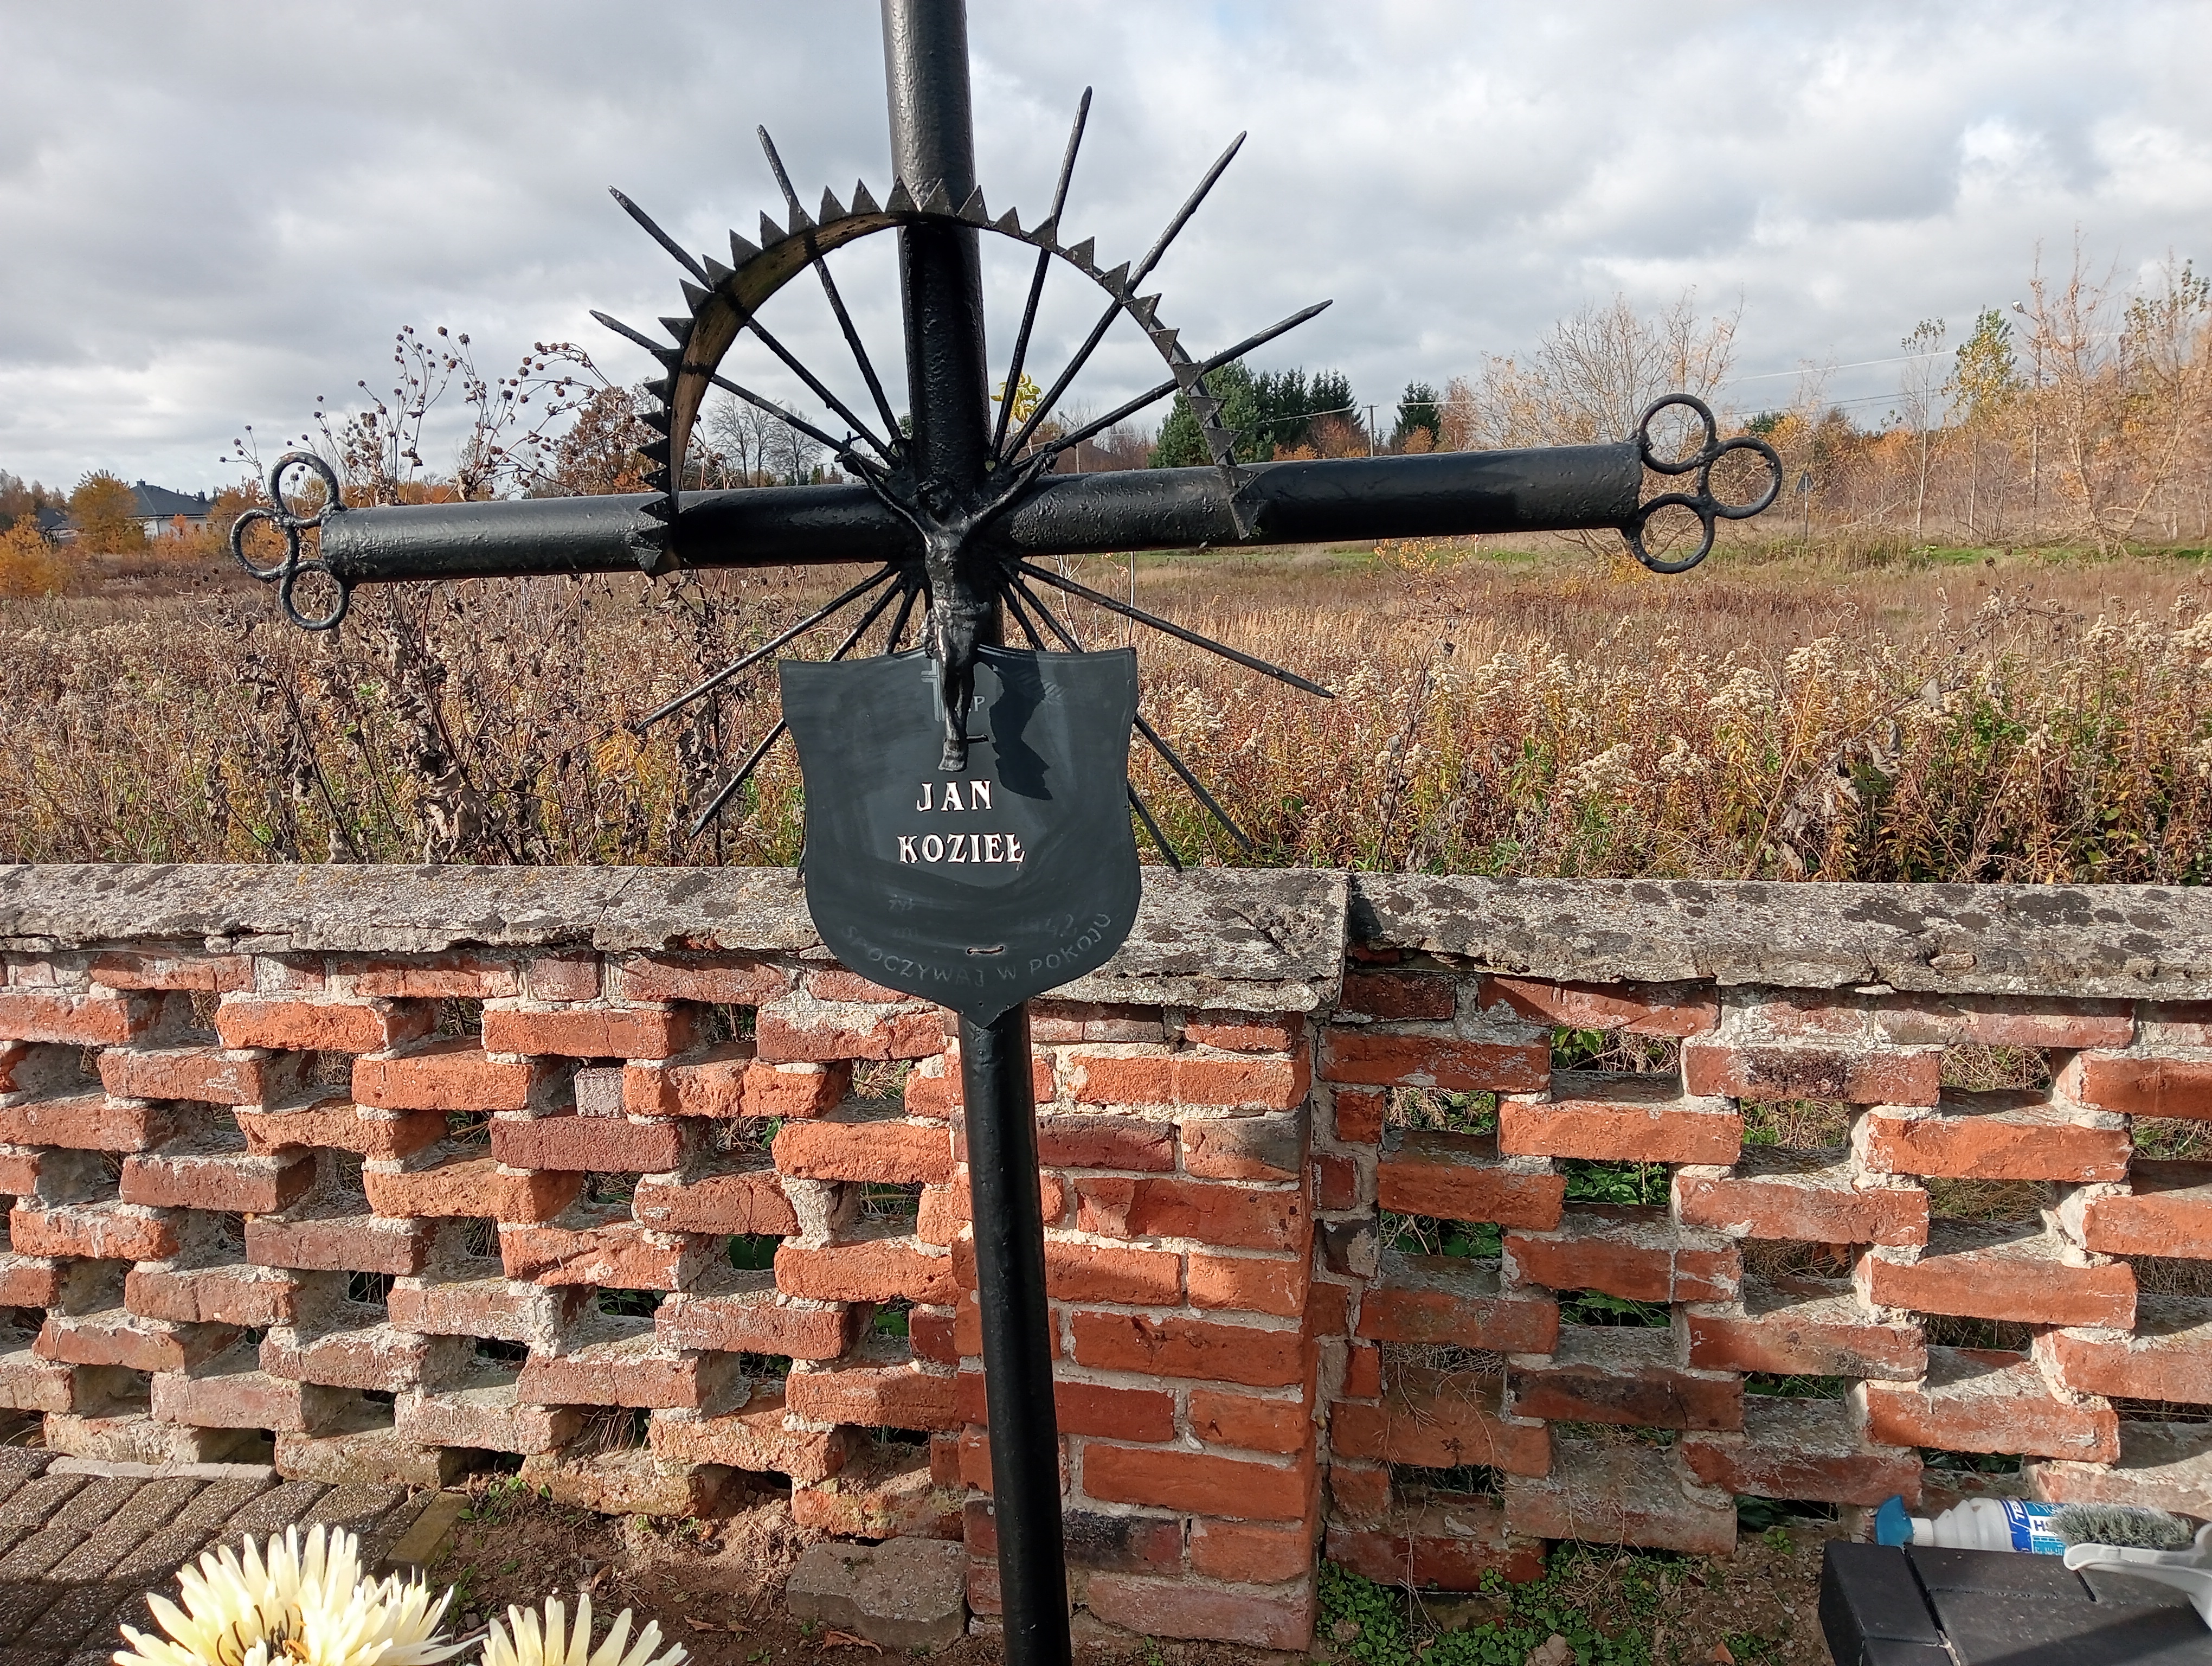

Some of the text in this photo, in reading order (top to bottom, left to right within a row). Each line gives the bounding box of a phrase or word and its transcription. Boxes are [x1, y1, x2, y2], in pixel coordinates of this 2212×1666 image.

[916, 779, 993, 812] JAN
[896, 832, 1026, 864] KOZIEŁ
[996, 966, 1016, 980] W
[1030, 913, 1111, 976] POKOJU
